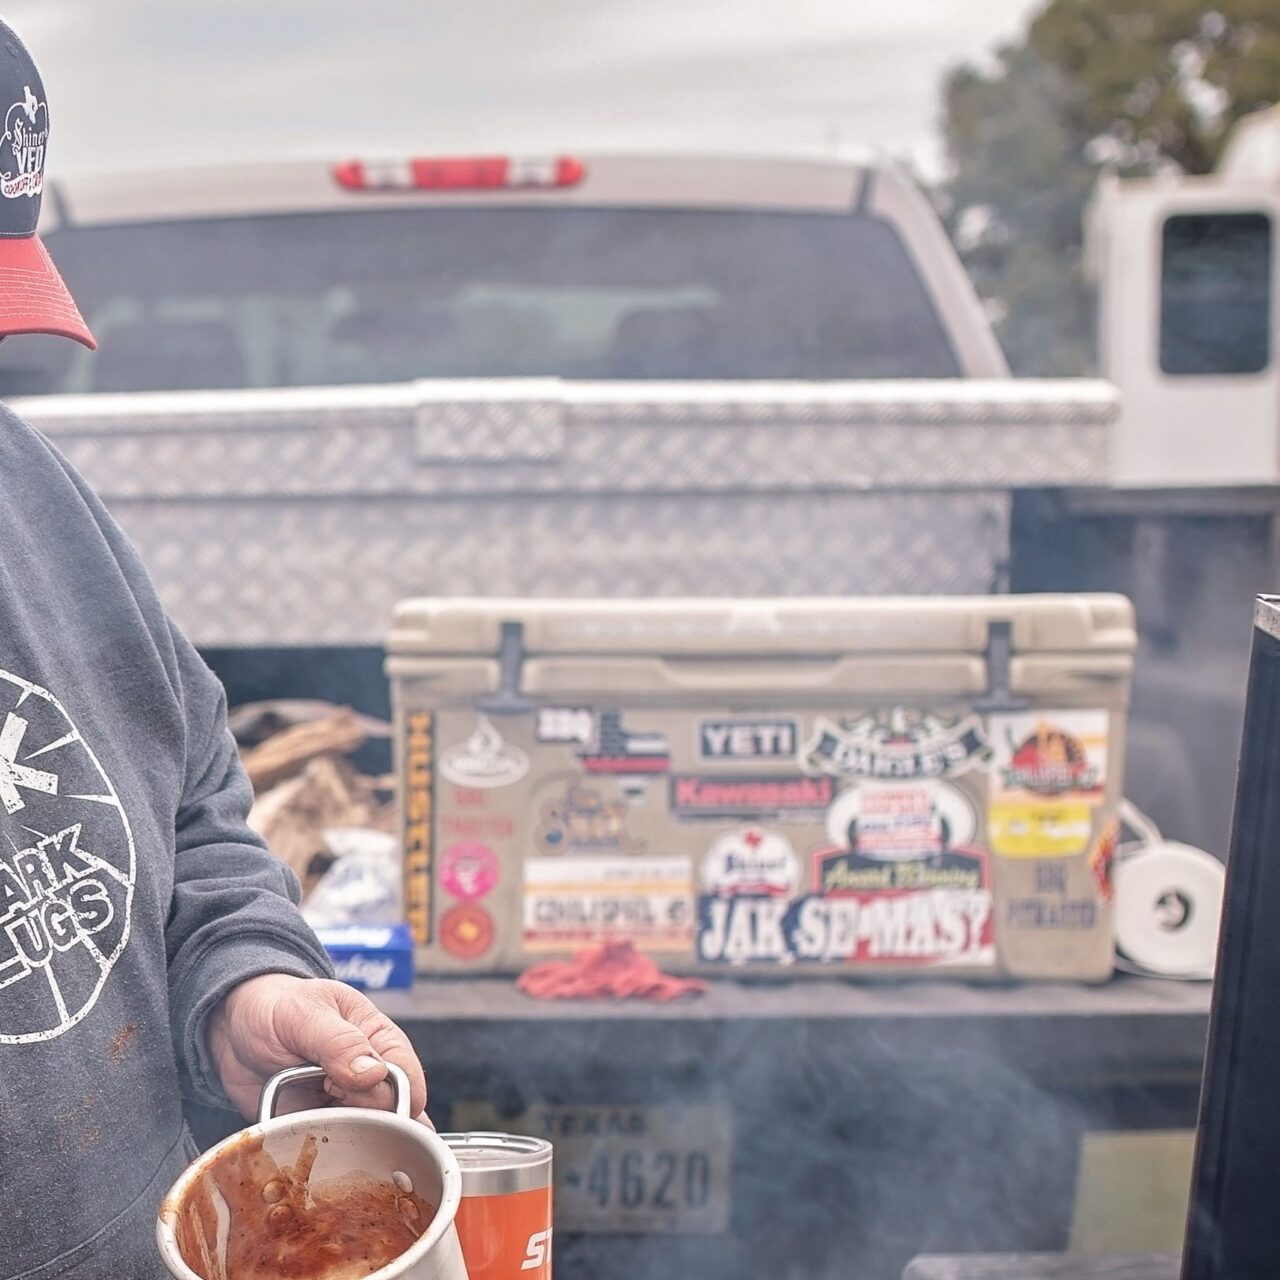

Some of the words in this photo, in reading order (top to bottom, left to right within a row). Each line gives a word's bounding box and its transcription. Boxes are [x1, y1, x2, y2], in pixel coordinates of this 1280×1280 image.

[12, 118, 46, 147] Shiner
[702, 724, 791, 754] YETI
[676, 777, 832, 806] Kawasaki
[701, 898, 790, 959] JAK
[798, 898, 858, 960] SE
[543, 1113, 647, 1134] TEXAS
